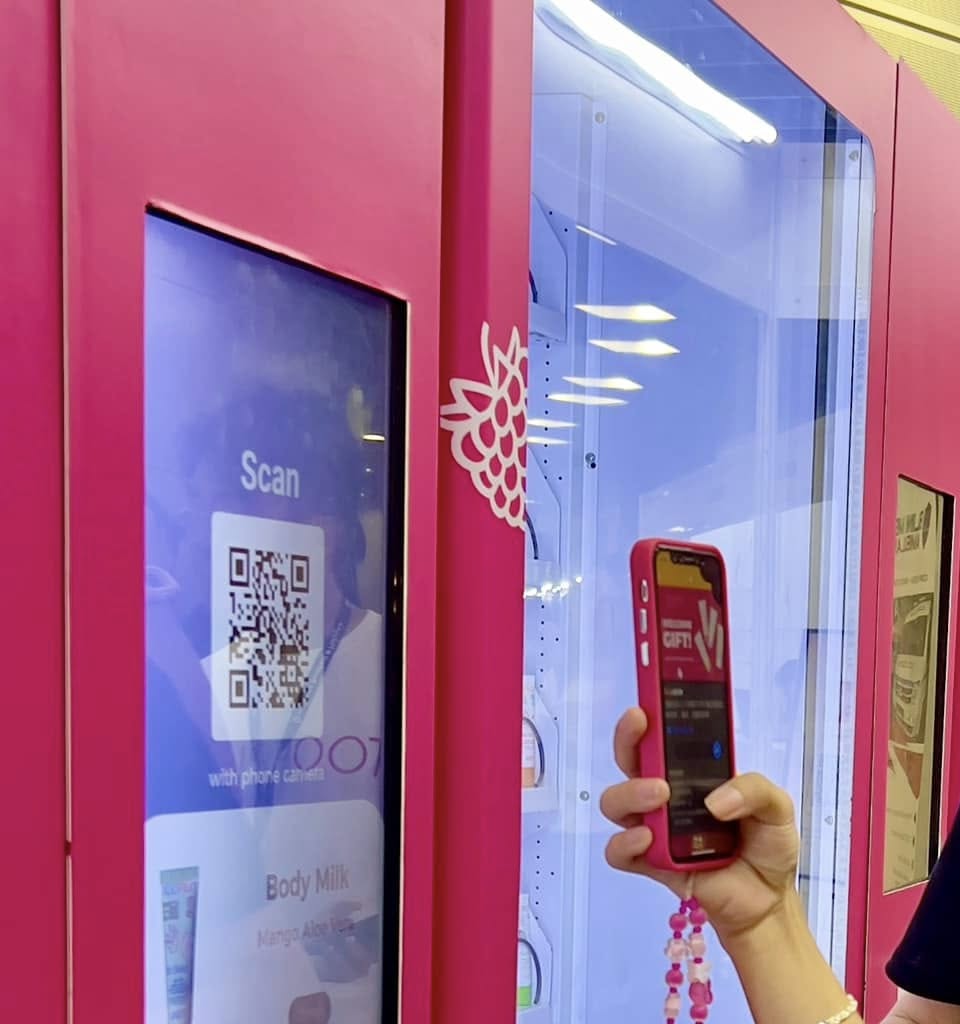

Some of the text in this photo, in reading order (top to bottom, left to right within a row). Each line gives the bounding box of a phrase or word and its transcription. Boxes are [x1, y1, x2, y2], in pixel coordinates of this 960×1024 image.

[241, 450, 299, 499] Scan
[208, 768, 238, 787] with
[241, 769, 280, 790] phone
[266, 864, 350, 902] Body Milk
